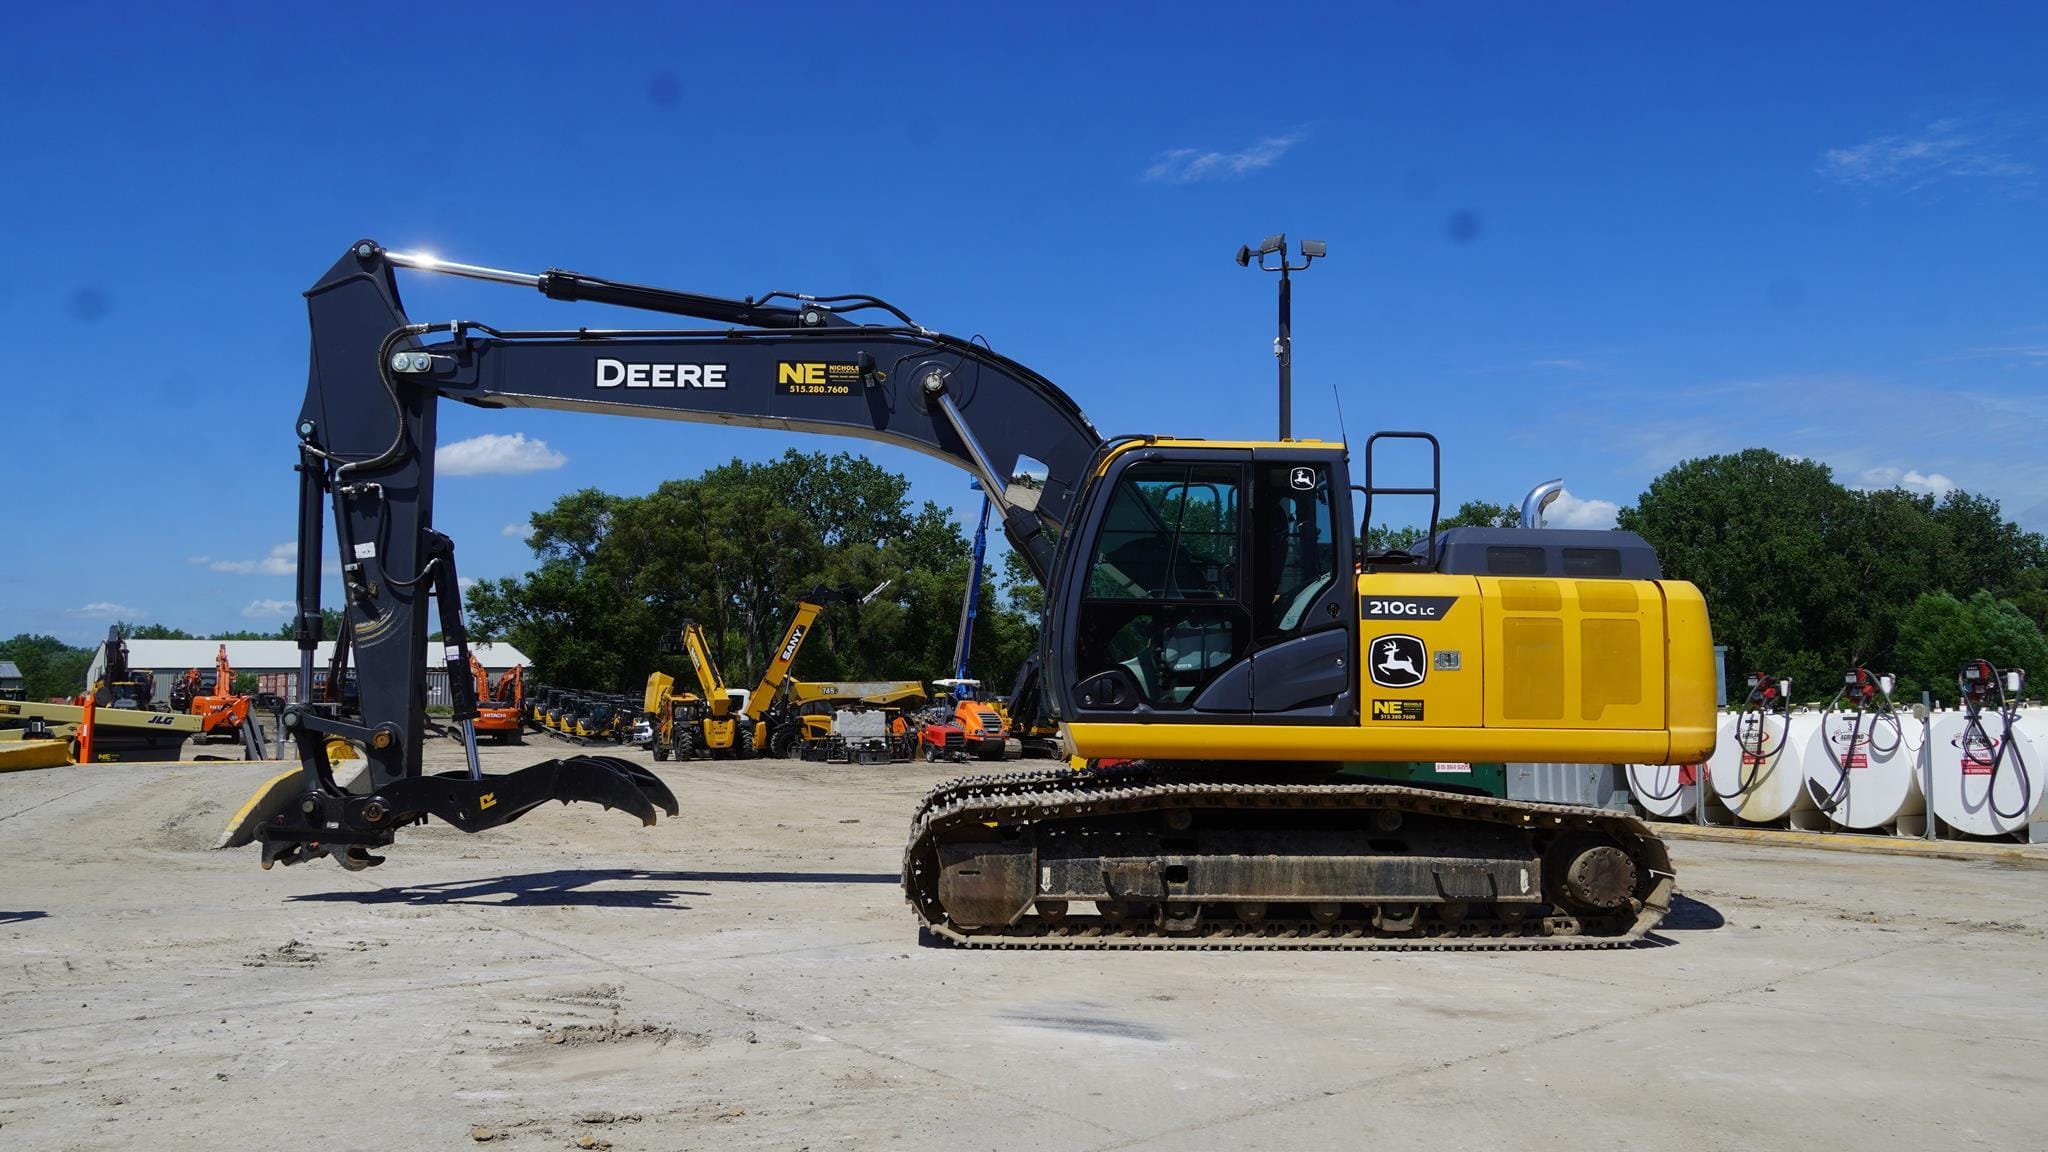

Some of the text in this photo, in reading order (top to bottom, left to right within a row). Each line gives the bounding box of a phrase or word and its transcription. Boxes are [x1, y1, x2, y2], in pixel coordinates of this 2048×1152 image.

[597, 359, 727, 387] DEERE
[779, 363, 826, 384] NE
[790, 385, 849, 393] 515.280.7600
[1370, 601, 1435, 615] 210G LC
[782, 628, 802, 660] SANY
[1374, 701, 1402, 713] NE
[148, 715, 175, 725] JLG
